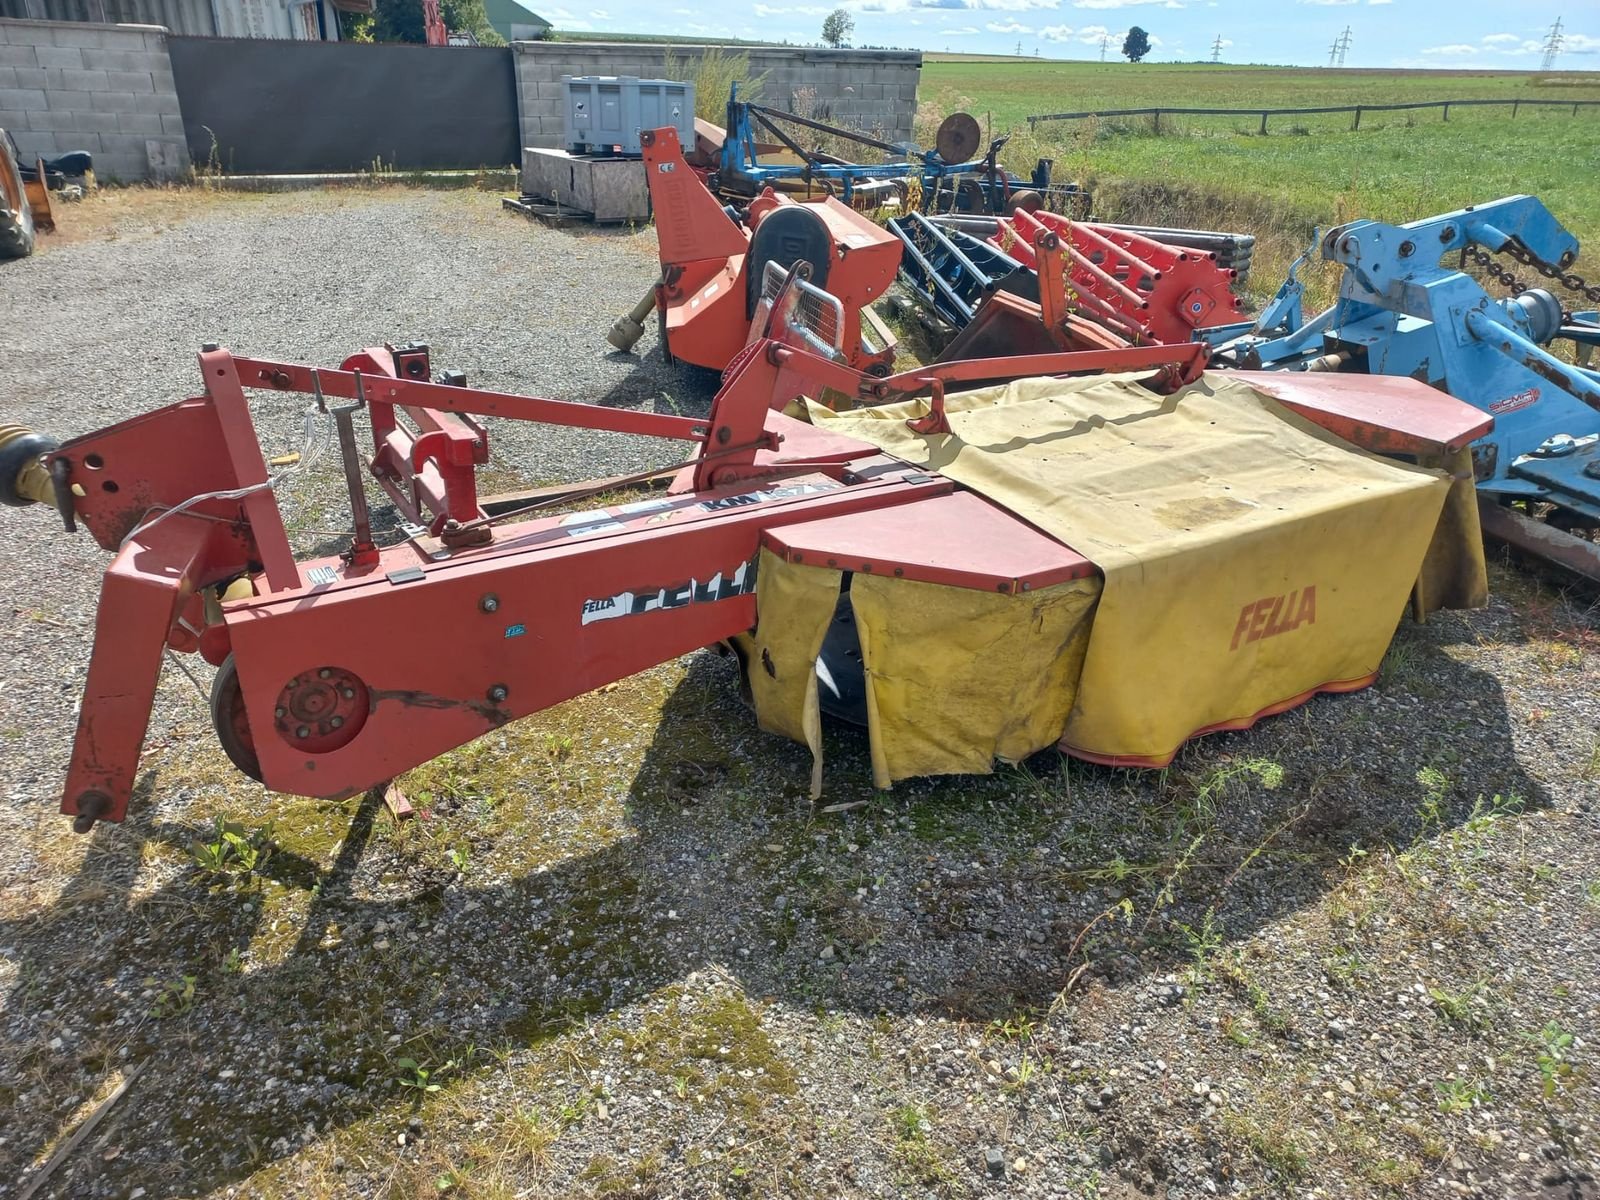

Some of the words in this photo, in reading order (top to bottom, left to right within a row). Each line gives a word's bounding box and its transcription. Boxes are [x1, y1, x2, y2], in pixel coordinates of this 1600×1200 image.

[701, 494, 758, 511] KM
[582, 598, 616, 615] FELLA
[1229, 585, 1316, 652] FELLA
